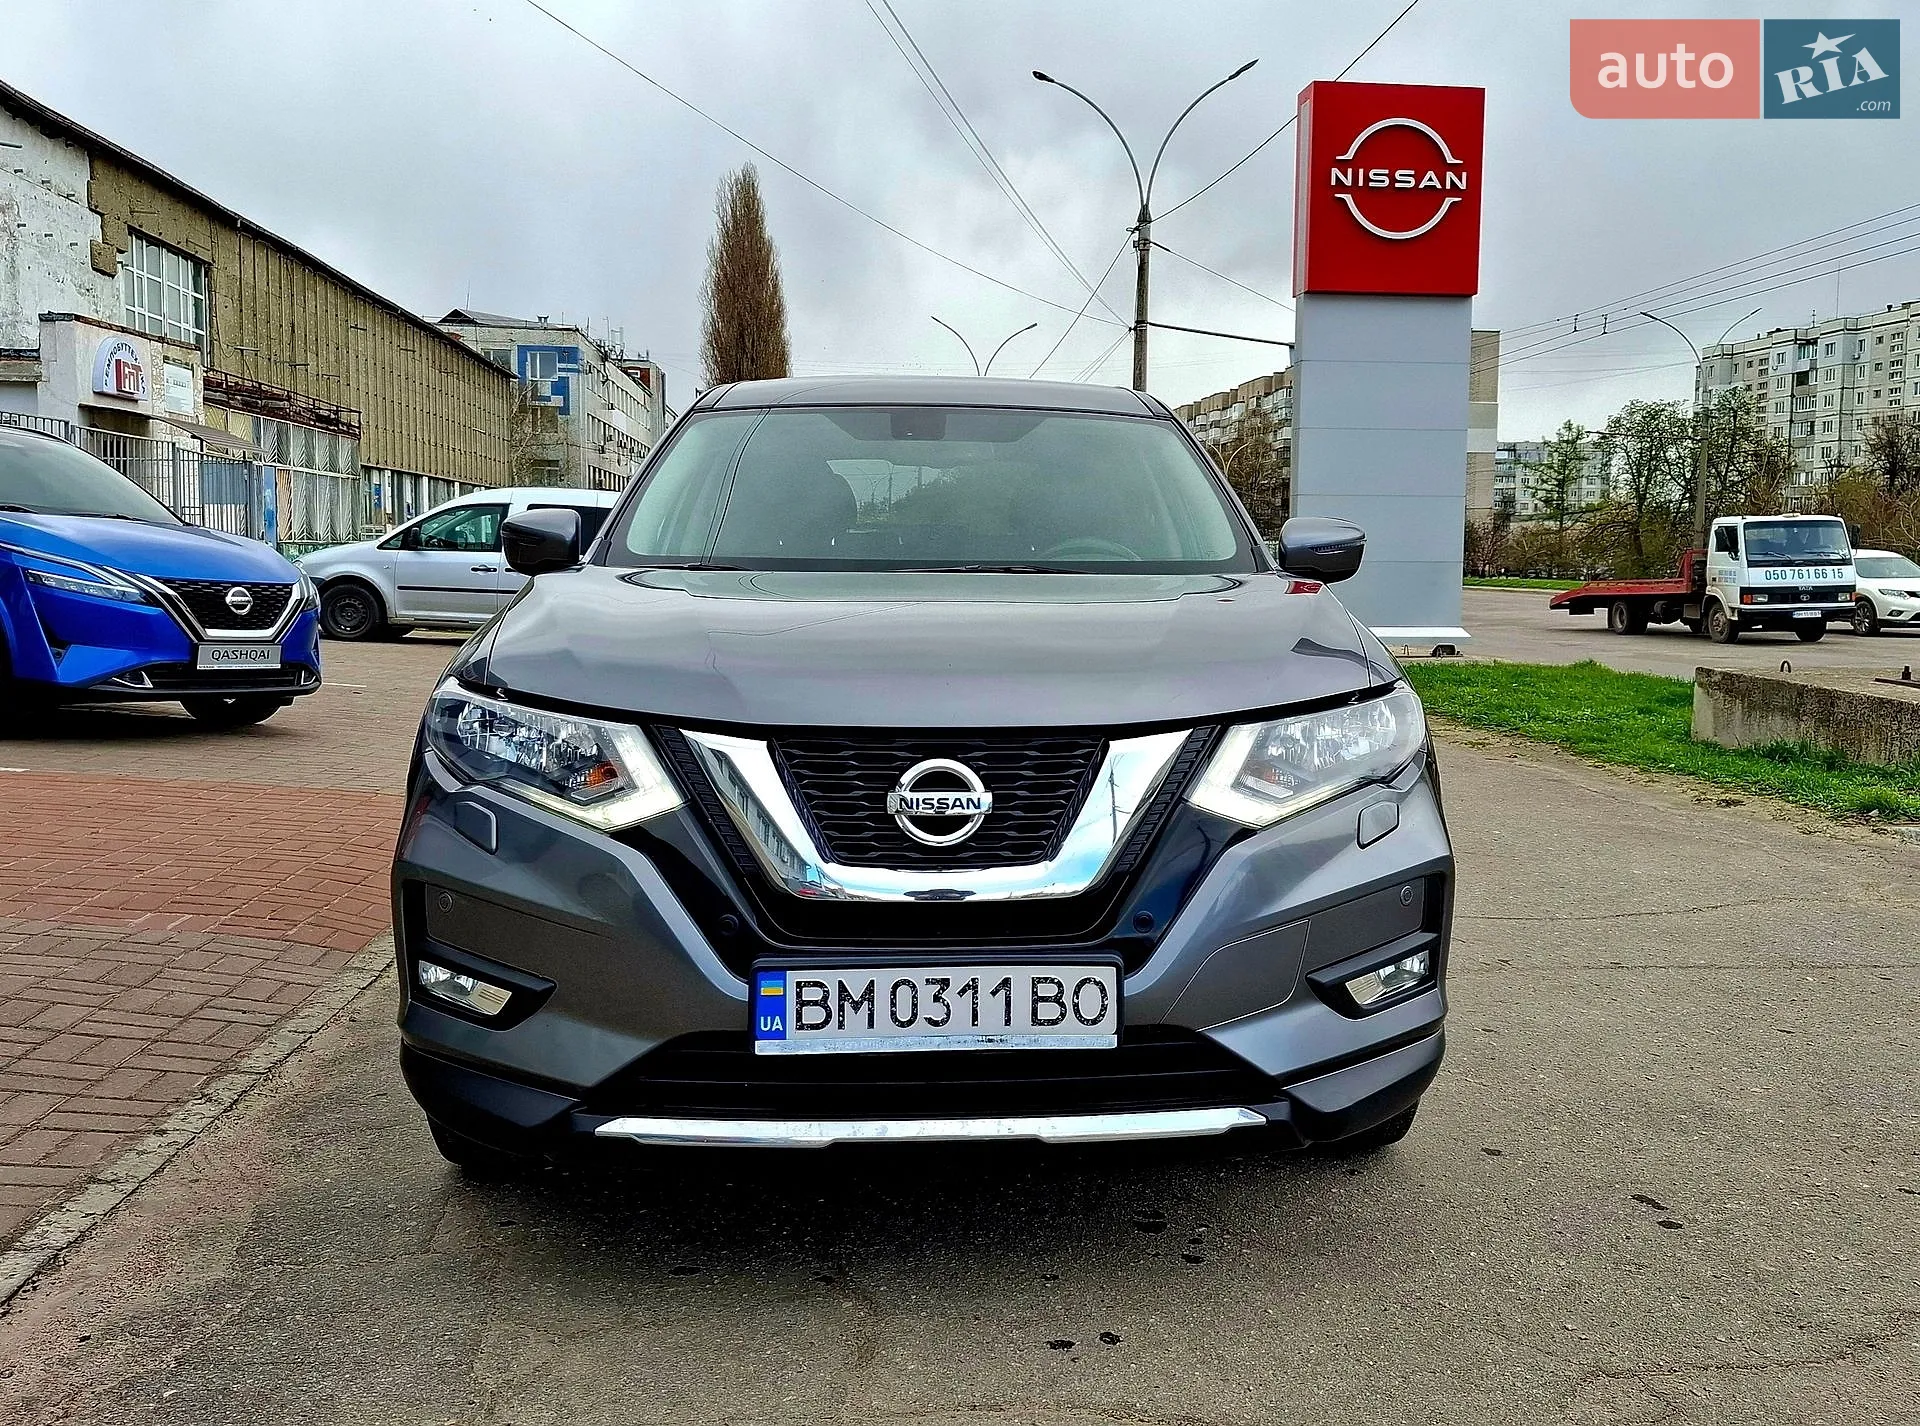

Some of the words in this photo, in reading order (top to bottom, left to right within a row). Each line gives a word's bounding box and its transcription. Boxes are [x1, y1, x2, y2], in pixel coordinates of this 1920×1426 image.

[1330, 168, 1467, 189] NISSAN
[1765, 570, 1787, 580] 050
[1790, 569, 1811, 580] 761
[1814, 569, 1828, 579] 66
[1831, 568, 1844, 579] 15
[211, 649, 270, 661] QASHQAI
[899, 797, 981, 810] NISSAN
[794, 978, 875, 1031] BM
[889, 977, 1012, 1029] 0311
[1030, 976, 1109, 1028] BO
[760, 1015, 783, 1032] UA
